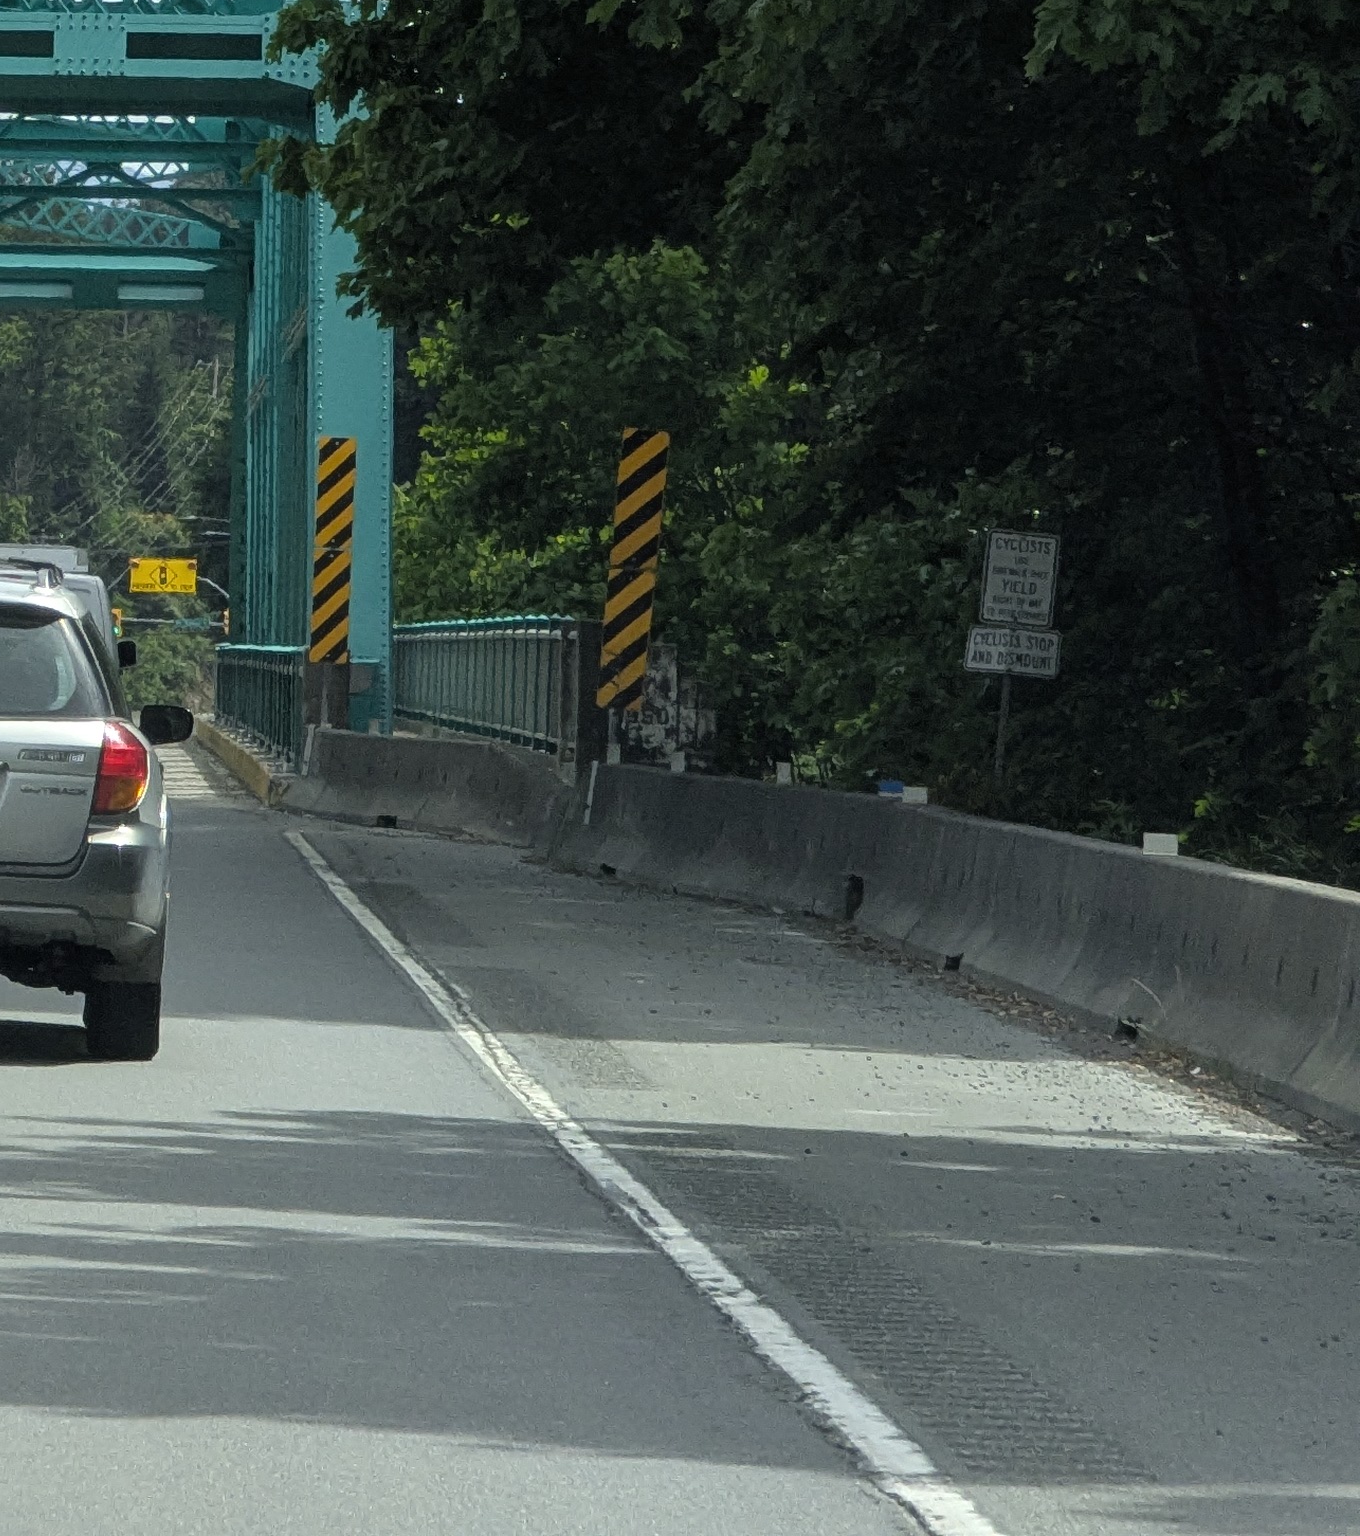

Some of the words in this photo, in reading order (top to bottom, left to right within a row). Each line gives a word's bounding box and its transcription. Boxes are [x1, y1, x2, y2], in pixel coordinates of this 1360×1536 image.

[995, 537, 1051, 555] CYCLISTS
[1002, 578, 1037, 595] YIELD
[973, 632, 1022, 649] CYCLISTS
[1026, 634, 1055, 652] STOP
[970, 650, 992, 664] AND
[996, 651, 1053, 670] DISMOUNT
